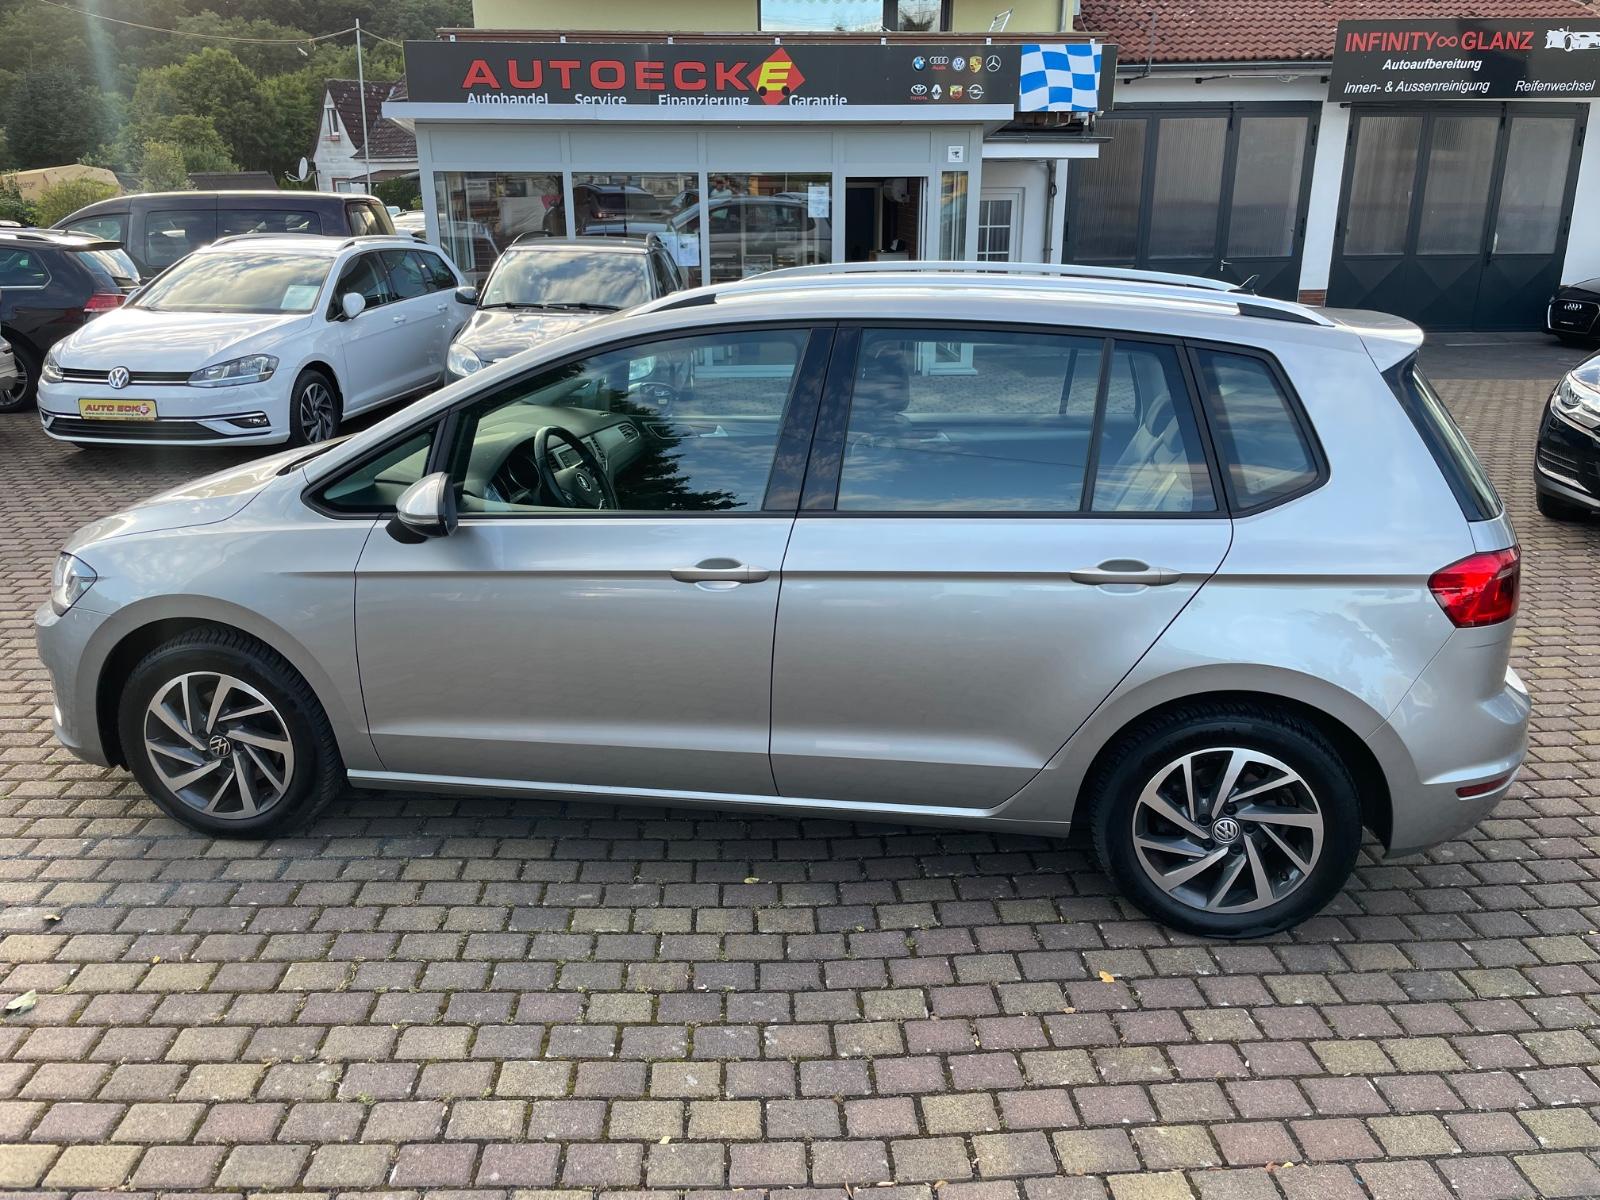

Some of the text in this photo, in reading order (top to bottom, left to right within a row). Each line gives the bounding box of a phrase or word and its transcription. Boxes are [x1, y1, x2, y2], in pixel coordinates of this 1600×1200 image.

[1344, 31, 1534, 52] INFINITY GLANZ
[1382, 58, 1482, 71] Autoaufbereitung
[1344, 80, 1490, 94] Innen- & Aussenreinigung
[1514, 79, 1596, 93] Reifenwechsel
[466, 93, 847, 105] Autohandel Service Finanzierung Garantie
[85, 404, 114, 412] AUTO
